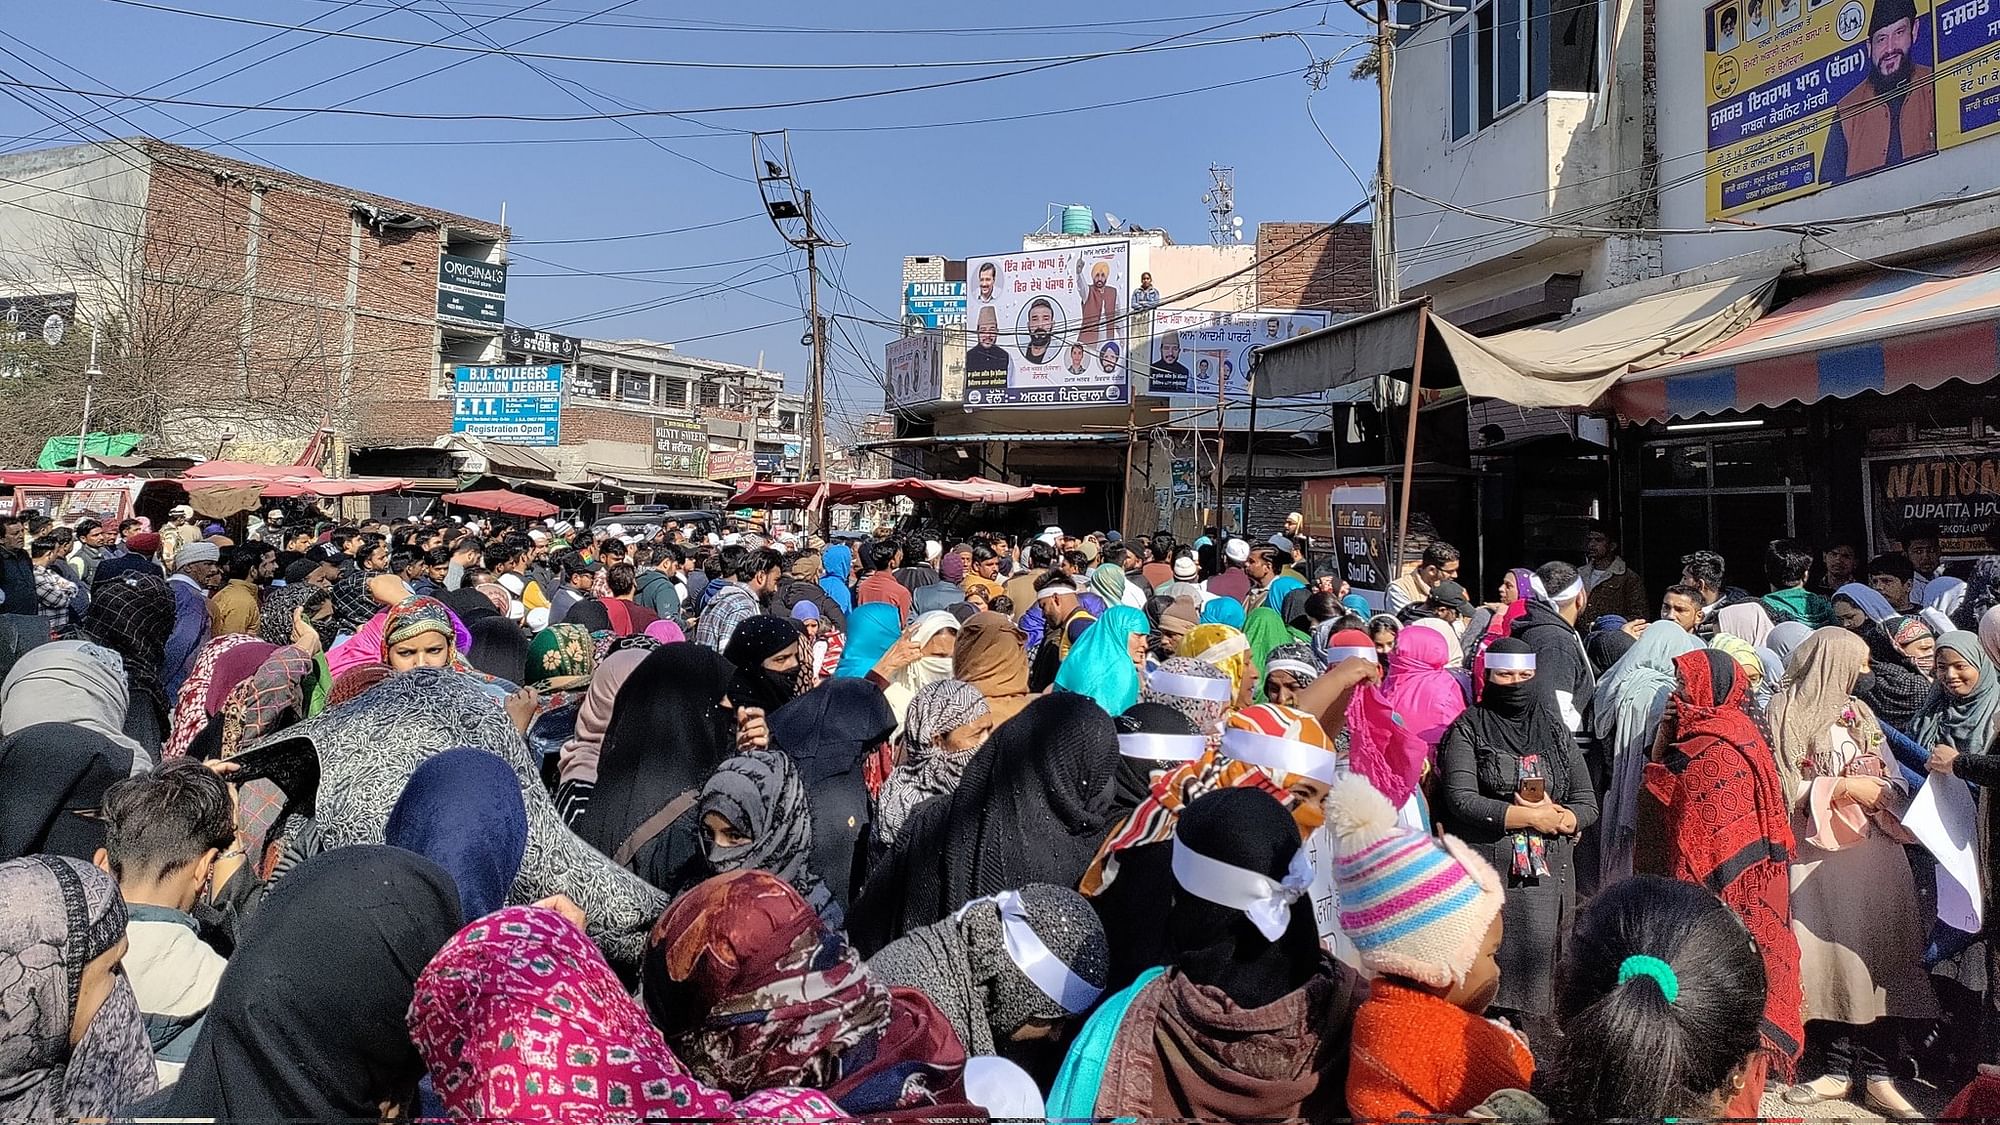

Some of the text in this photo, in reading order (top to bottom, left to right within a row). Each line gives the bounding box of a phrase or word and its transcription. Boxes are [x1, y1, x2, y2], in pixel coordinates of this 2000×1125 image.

[1711, 102, 1742, 131] ਨੁਸਰਤ
[1748, 82, 1791, 113] ਇਕਰਾਮ
[1826, 49, 1865, 84] (ਬੱਗਾ)
[1740, 90, 1829, 135] ਸਾਬਕਾ ਕੈਬਨਿਟ ਮੰਤਰੀ
[1038, 259, 1055, 269] ਆਪ
[445, 261, 503, 283] ORIGINAL'S
[914, 283, 956, 295] PUNEET
[1014, 280, 1027, 292] ਫਿਰ
[1045, 277, 1064, 290] ਪੰਜਾਬ
[534, 331, 550, 341] THE
[1199, 329, 1224, 341] ਆਦਮੀ
[1228, 329, 1251, 342] ਪਾਰਟੀ
[524, 338, 559, 353] STORE
[494, 367, 548, 380] COLLEGES
[458, 381, 508, 392] EDUCATION
[512, 380, 558, 392] DEGREE
[1020, 391, 1056, 402] ਅਕਬਰ
[456, 398, 497, 415] E.T.T.
[468, 425, 543, 434] Registration Open
[656, 427, 706, 442] BUNTY SWEETS
[1904, 503, 1970, 518] DUPATTA
[1344, 536, 1378, 559] Hijab &
[1348, 562, 1376, 583] Stoll's
